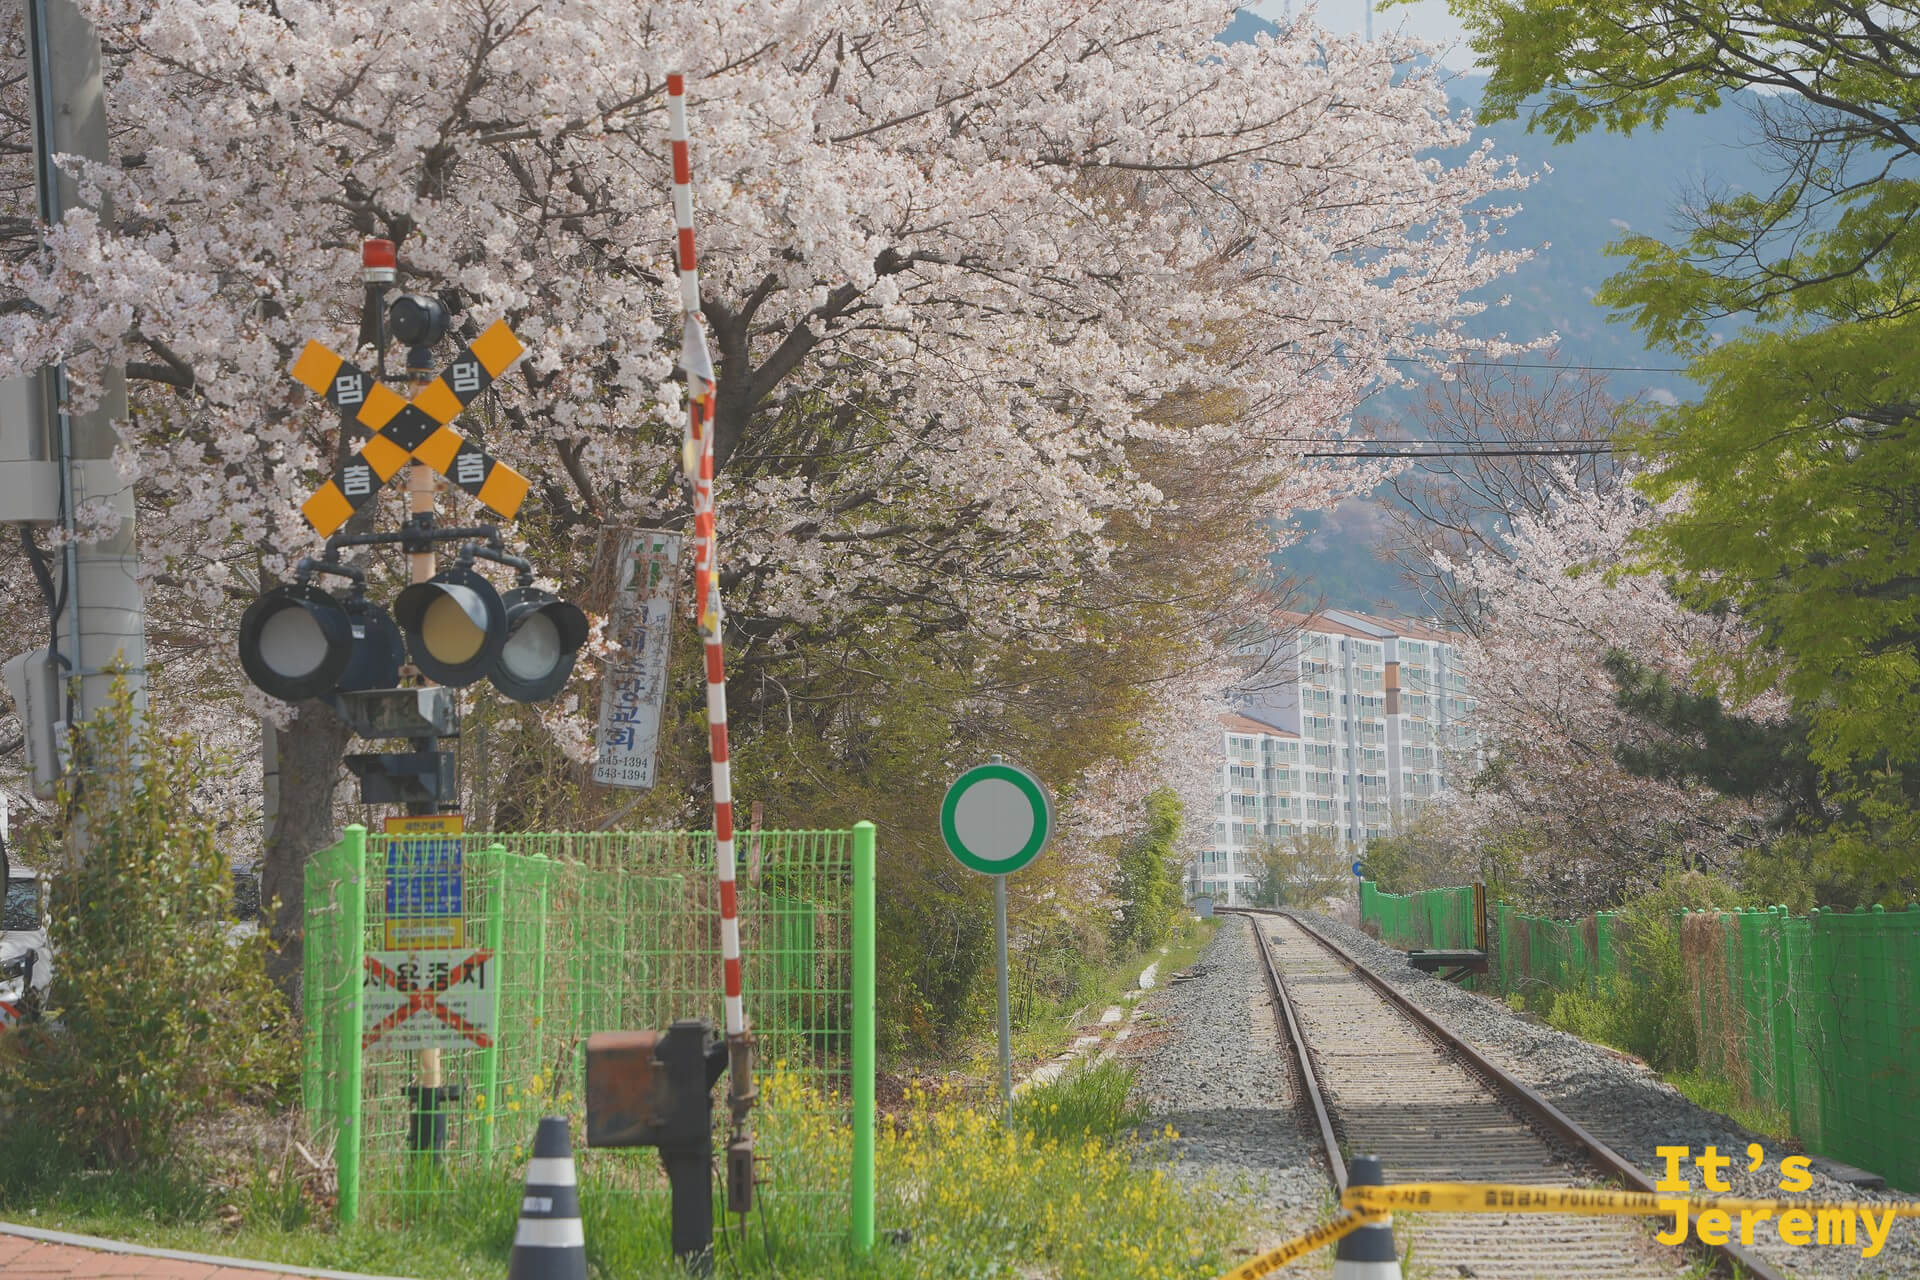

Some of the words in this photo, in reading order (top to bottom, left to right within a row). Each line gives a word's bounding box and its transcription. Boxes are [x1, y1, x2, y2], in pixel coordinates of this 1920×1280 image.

[336, 374, 363, 405] 멈
[452, 361, 480, 392] 멈
[343, 465, 371, 496] 춤
[457, 452, 484, 484] 춤
[363, 962, 485, 992] 사용중지
[1485, 1190, 1547, 1206] 출입금지
[1560, 1192, 1614, 1207] POLICE
[1624, 1194, 1657, 1208] LINE
